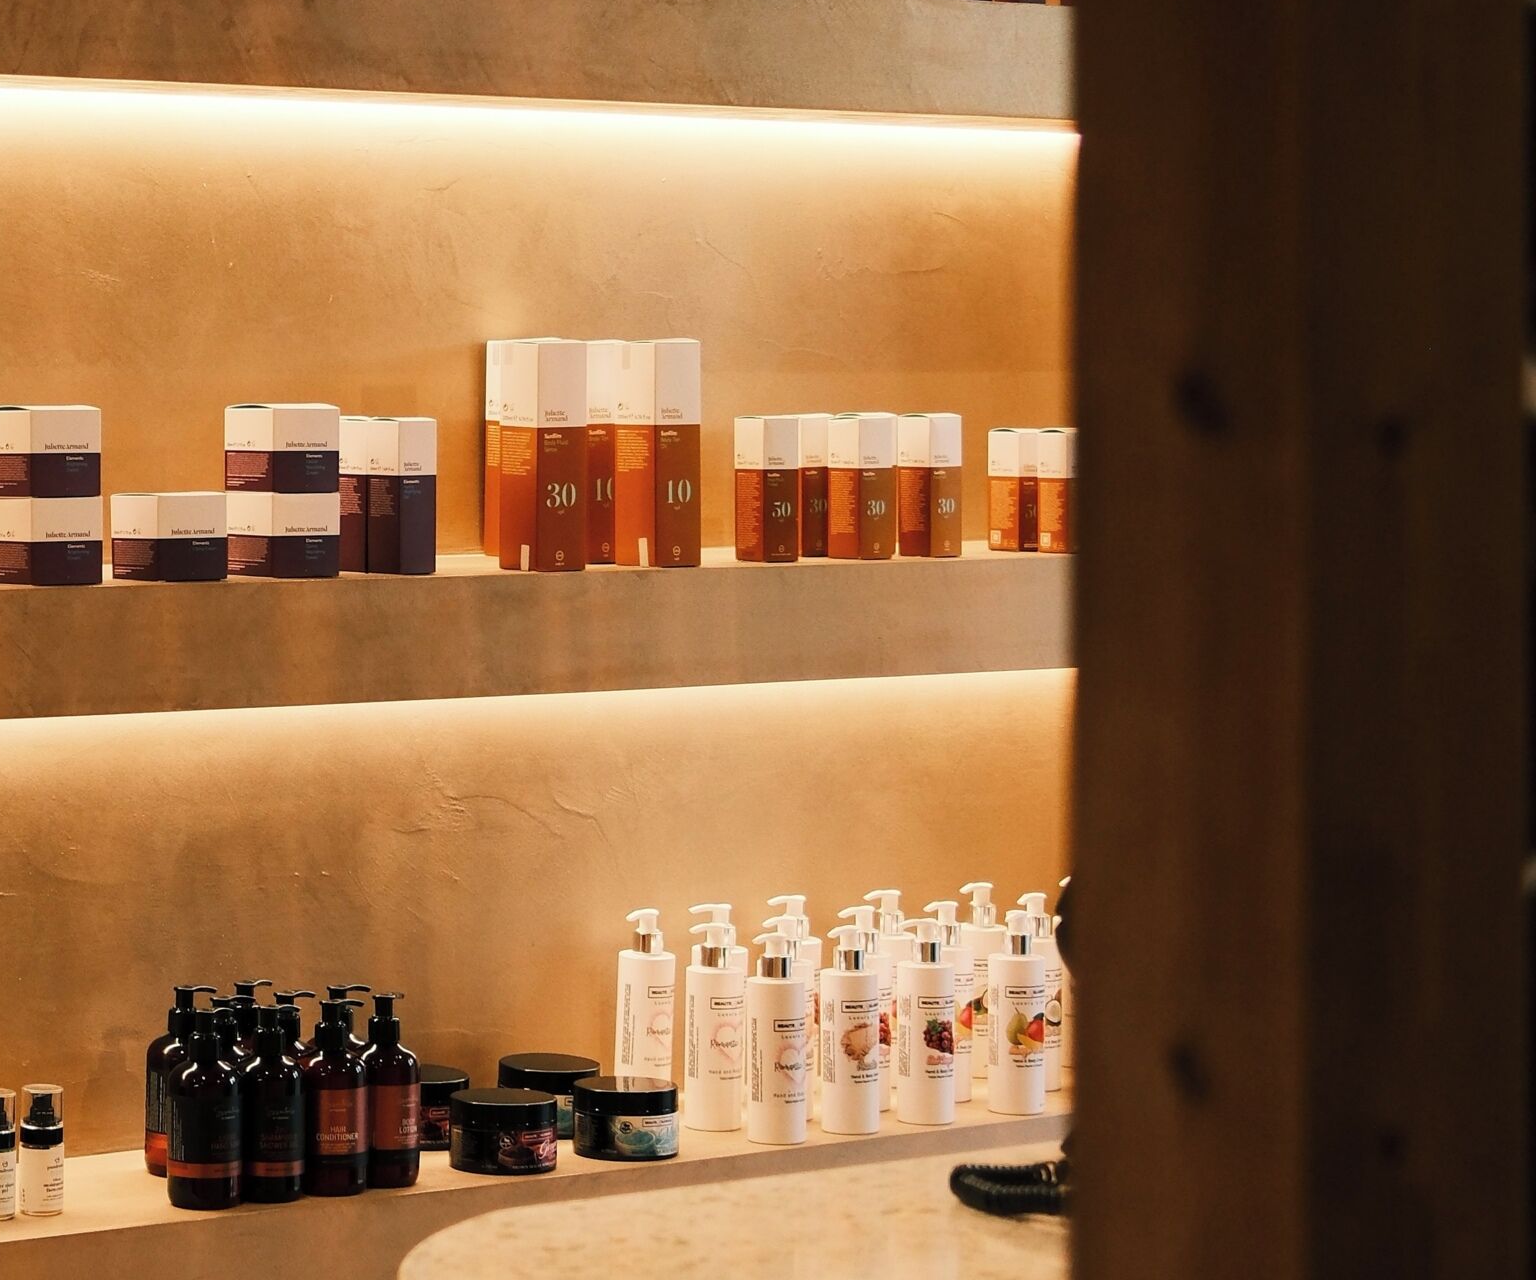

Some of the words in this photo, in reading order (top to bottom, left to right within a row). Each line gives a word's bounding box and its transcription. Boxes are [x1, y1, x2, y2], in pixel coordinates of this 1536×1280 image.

[44, 443, 65, 451] Juliette
[67, 442, 89, 450] Armand
[285, 440, 305, 448] Juliette
[546, 482, 576, 508] 30
[667, 479, 692, 503] 10
[772, 501, 792, 519] 50
[867, 499, 886, 516] 30
[937, 498, 955, 515] 30
[170, 528, 191, 536] Juliette
[192, 527, 215, 535] Armand
[284, 525, 305, 533] Juliette
[45, 531, 65, 539] Juliette
[67, 530, 91, 538] Armand
[316, 1132, 359, 1141] CONDITIONER
